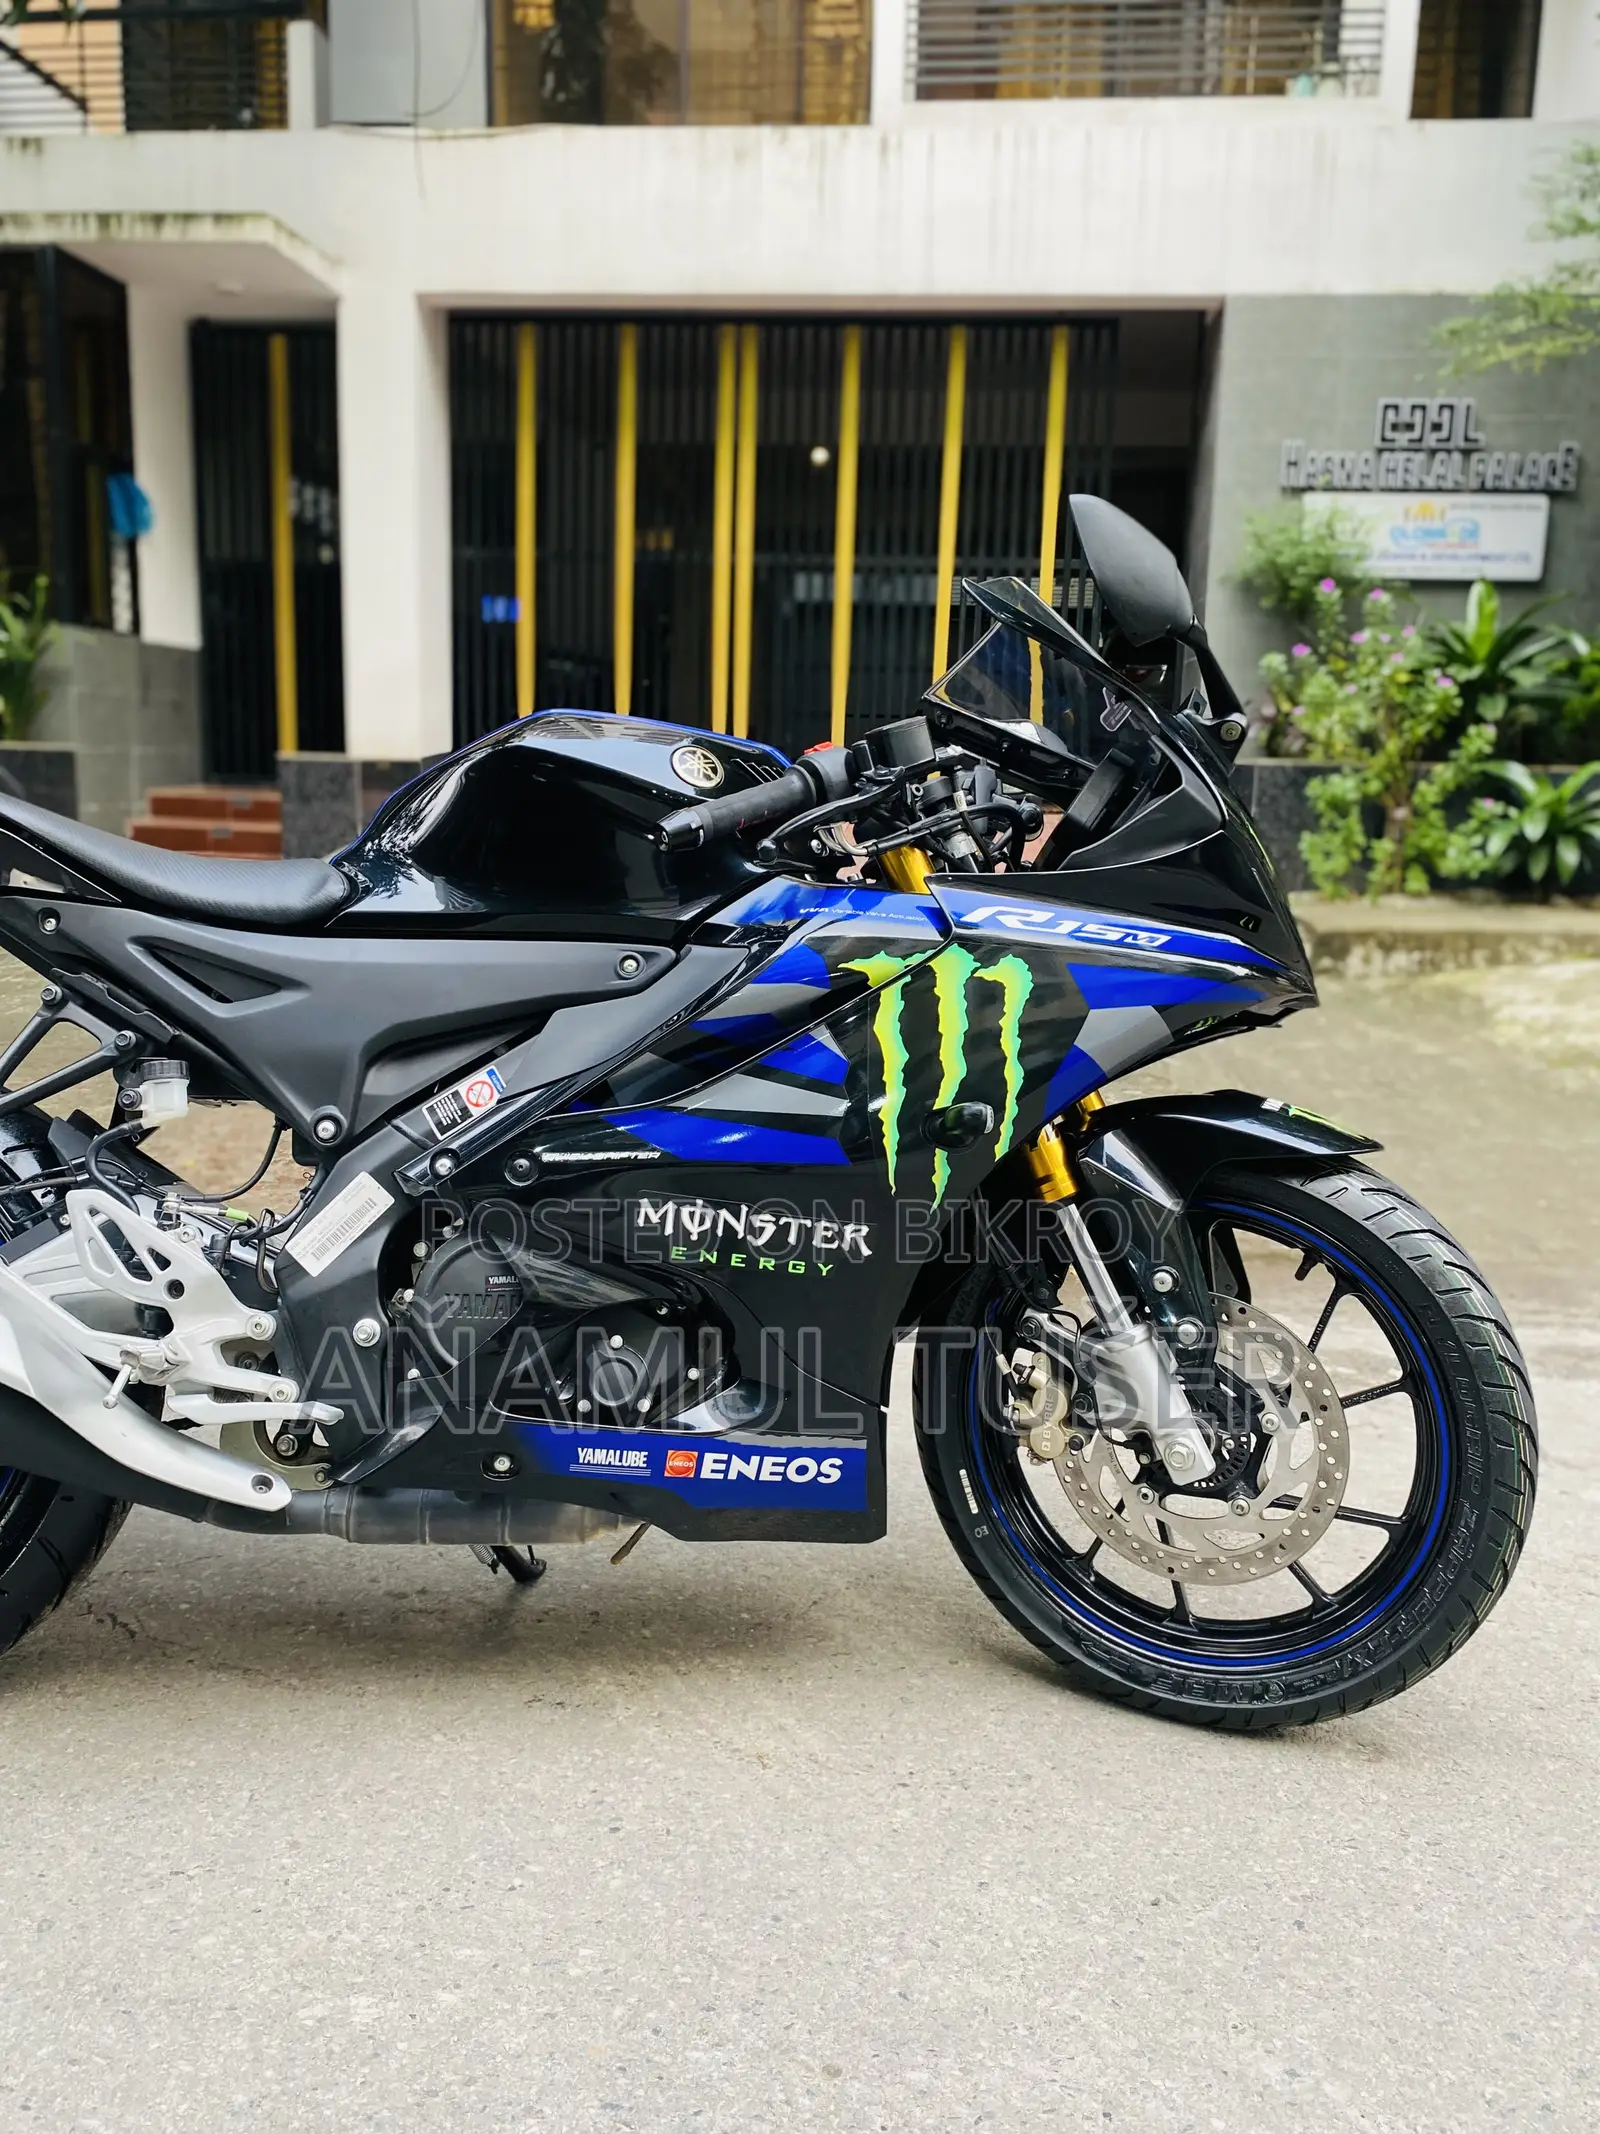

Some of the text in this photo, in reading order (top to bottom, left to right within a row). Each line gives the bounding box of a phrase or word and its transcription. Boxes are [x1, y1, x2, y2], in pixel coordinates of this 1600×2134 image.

[832, 908, 864, 916] Variable
[865, 910, 887, 918] Valve
[888, 913, 929, 922] Actuation
[637, 1198, 873, 1257] MONSTER
[671, 1246, 834, 1277] ENERGY
[577, 1447, 648, 1468] YAMALUBE
[669, 1460, 694, 1468] ENEOS
[700, 1452, 844, 1485] ENEOS
